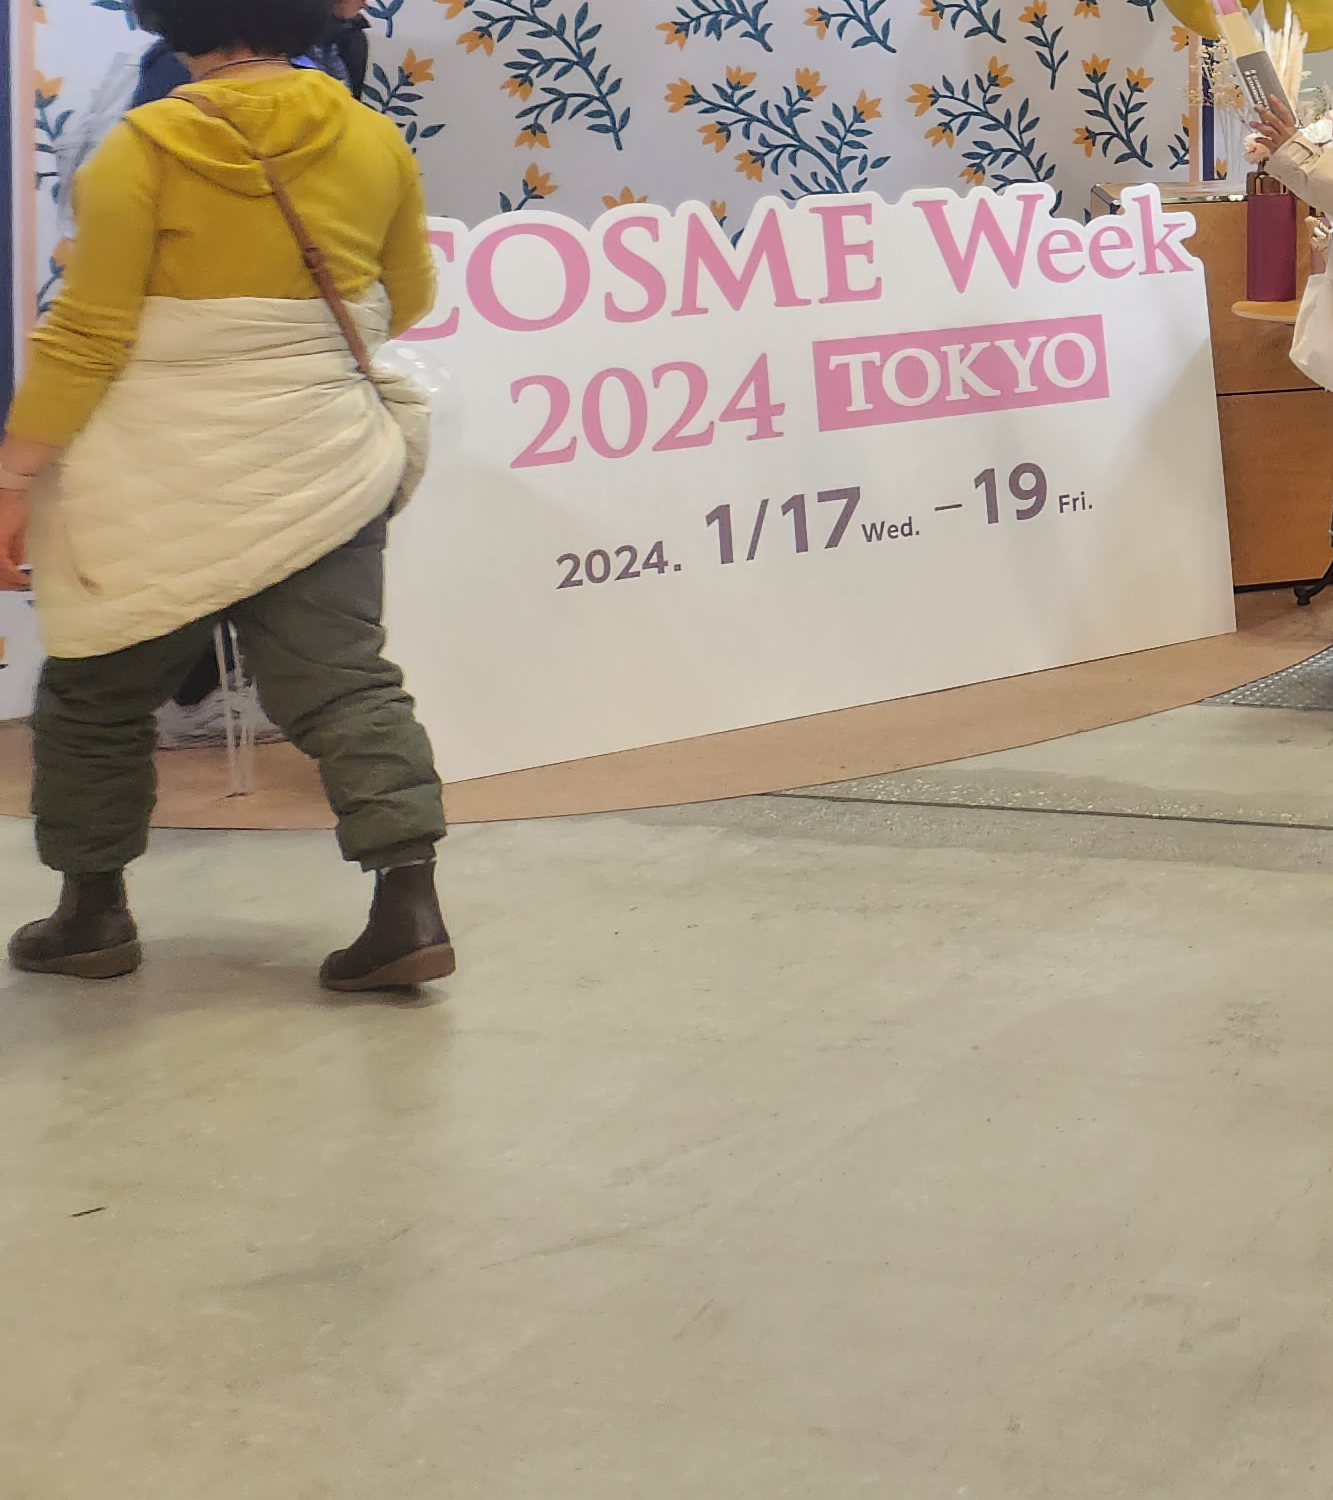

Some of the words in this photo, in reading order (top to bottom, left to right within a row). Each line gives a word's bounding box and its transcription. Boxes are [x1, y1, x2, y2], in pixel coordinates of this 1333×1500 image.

[913, 190, 1195, 294] Week
[509, 352, 787, 470] 2024
[827, 331, 1099, 413] TOKYO
[555, 540, 683, 591] 2024.
[703, 485, 863, 568] 1/17
[861, 514, 921, 545] Wed.
[1057, 489, 1095, 516] Fri.
